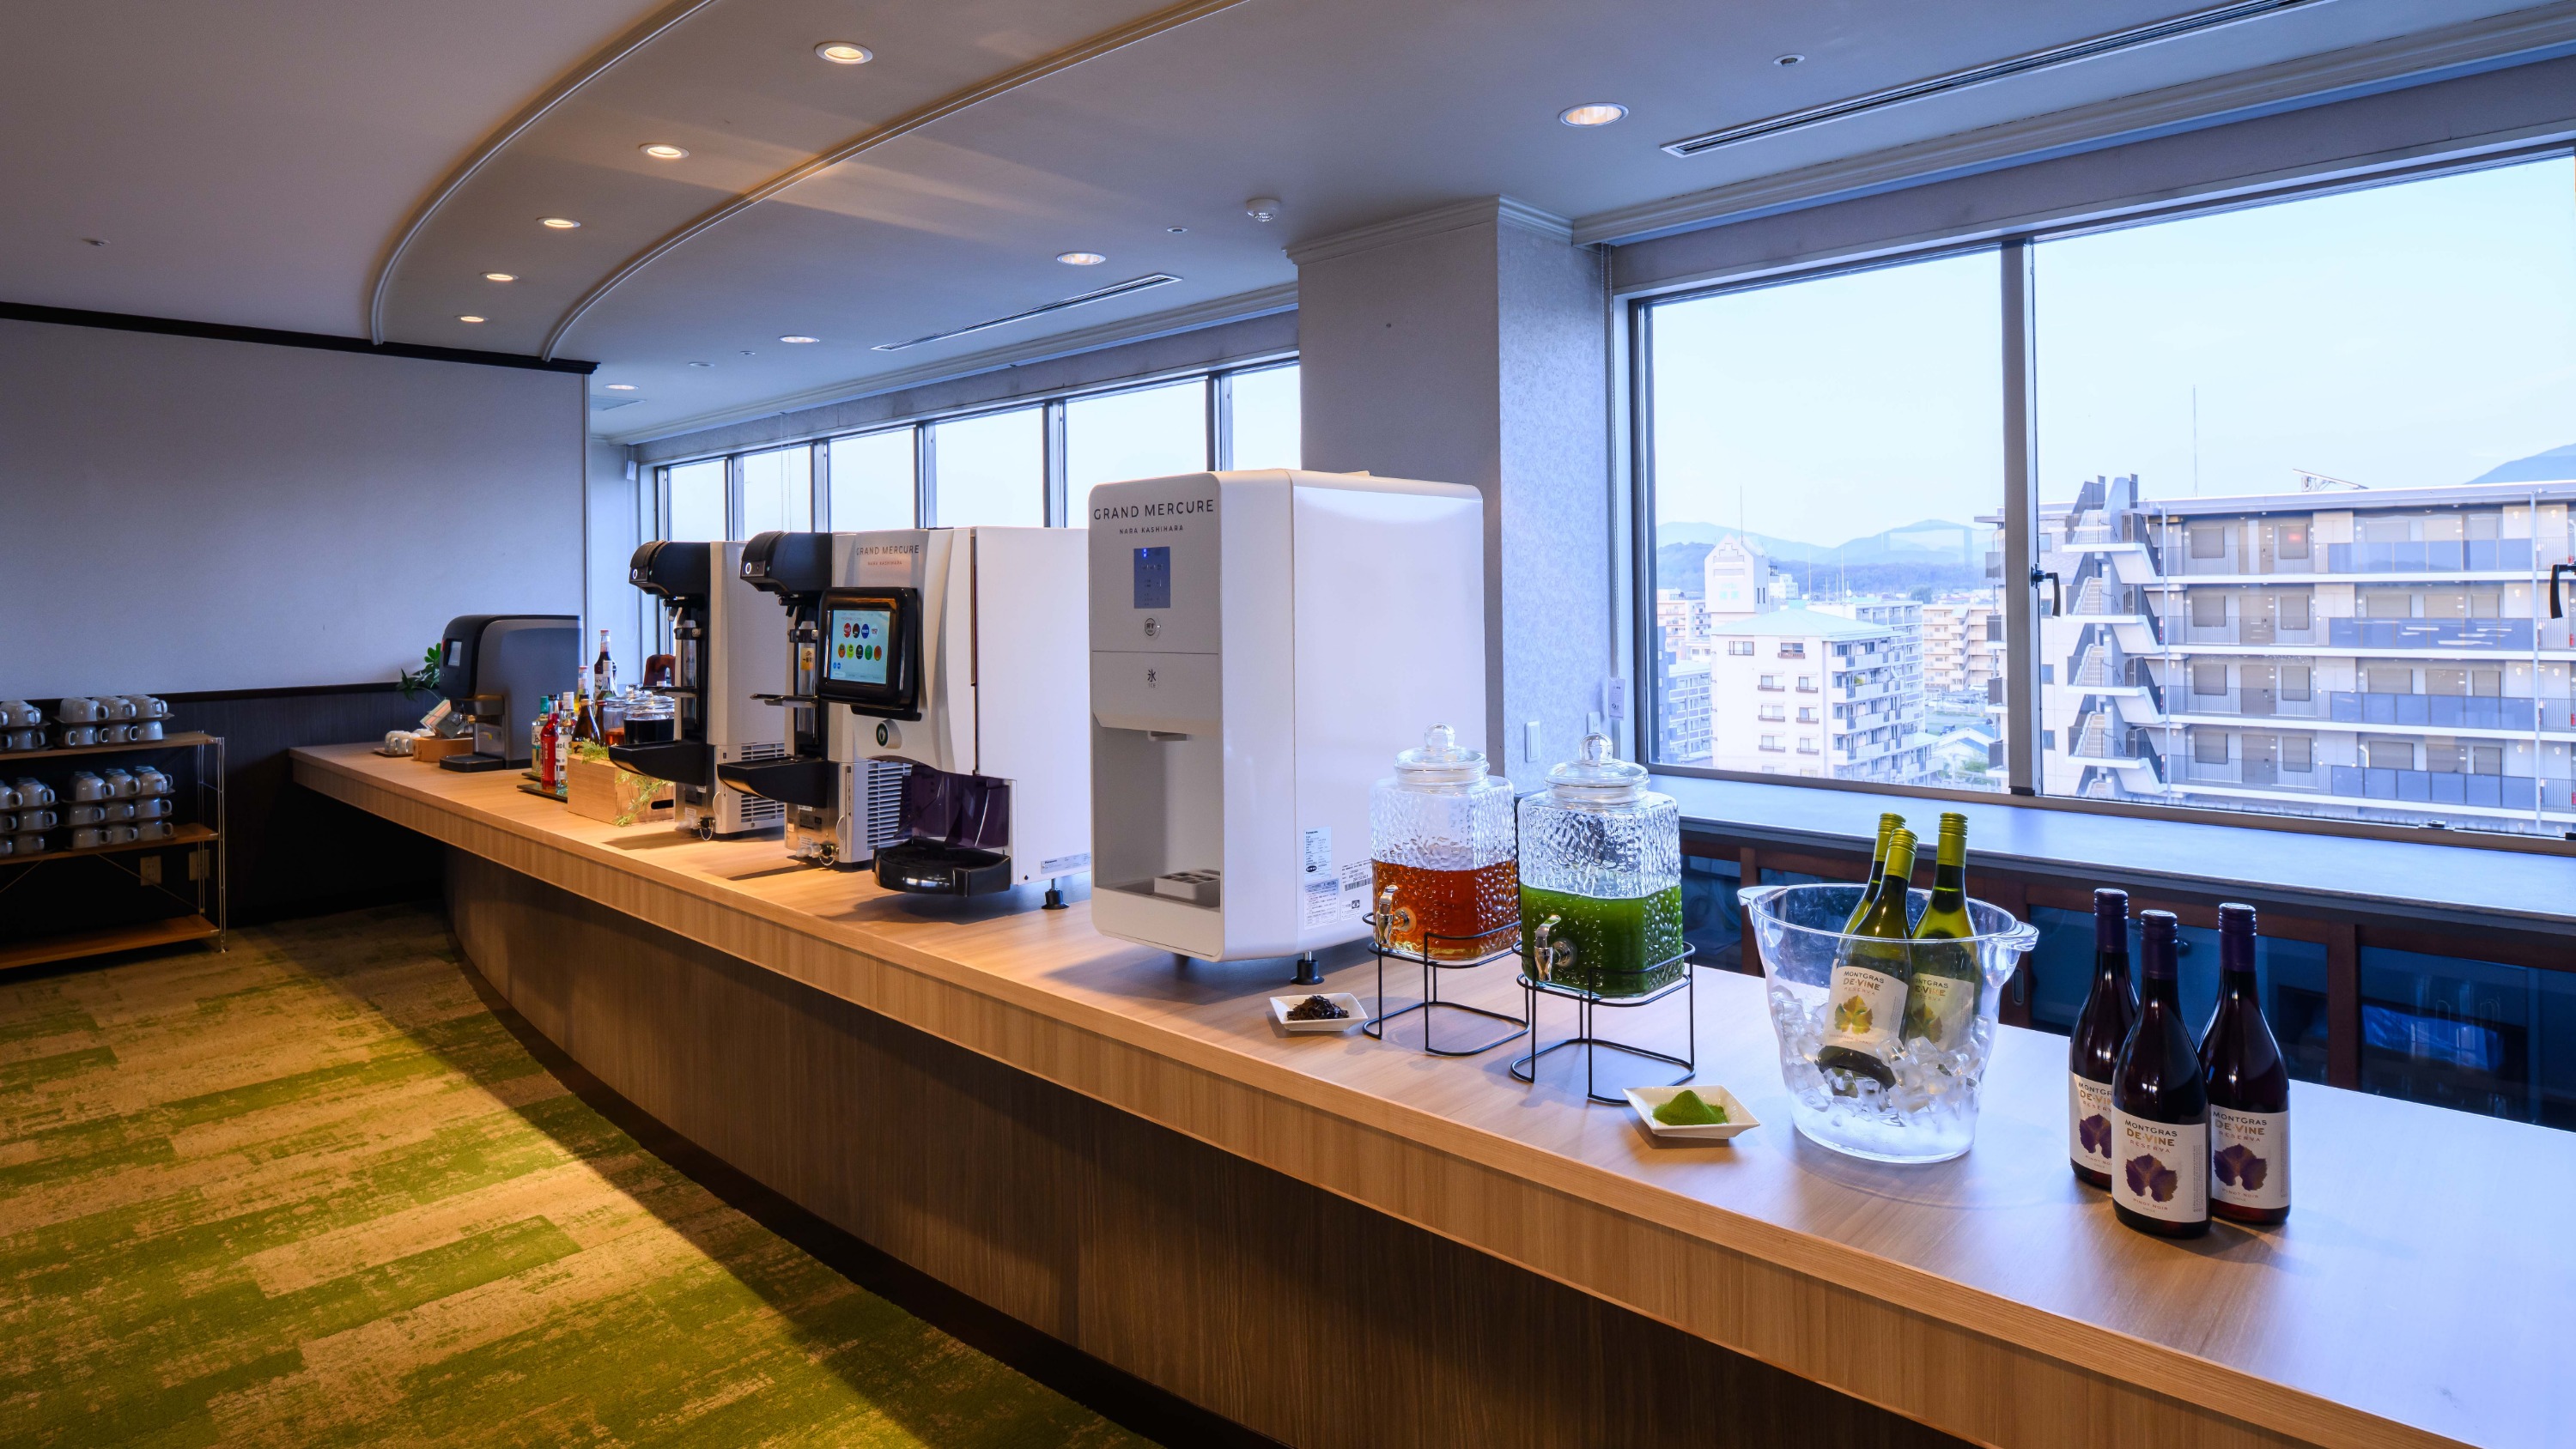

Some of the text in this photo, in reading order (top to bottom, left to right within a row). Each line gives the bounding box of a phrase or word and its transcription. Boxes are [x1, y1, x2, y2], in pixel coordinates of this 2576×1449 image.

[1094, 499, 1214, 520] GRAND MERCURE
[1141, 524, 1184, 534] KASHIHARA
[882, 544, 920, 555] MERCURE
[1147, 669, 1157, 682] 氷
[1844, 971, 1885, 984] MONTGRAS
[2078, 1082, 2112, 1096] MONTGR
[2213, 1111, 2268, 1126] MONTGRAS
[2124, 1119, 2178, 1137] MONTGRAS
[2218, 1131, 2261, 1143] RESERVA
[2129, 1139, 2171, 1154] RESERVA
